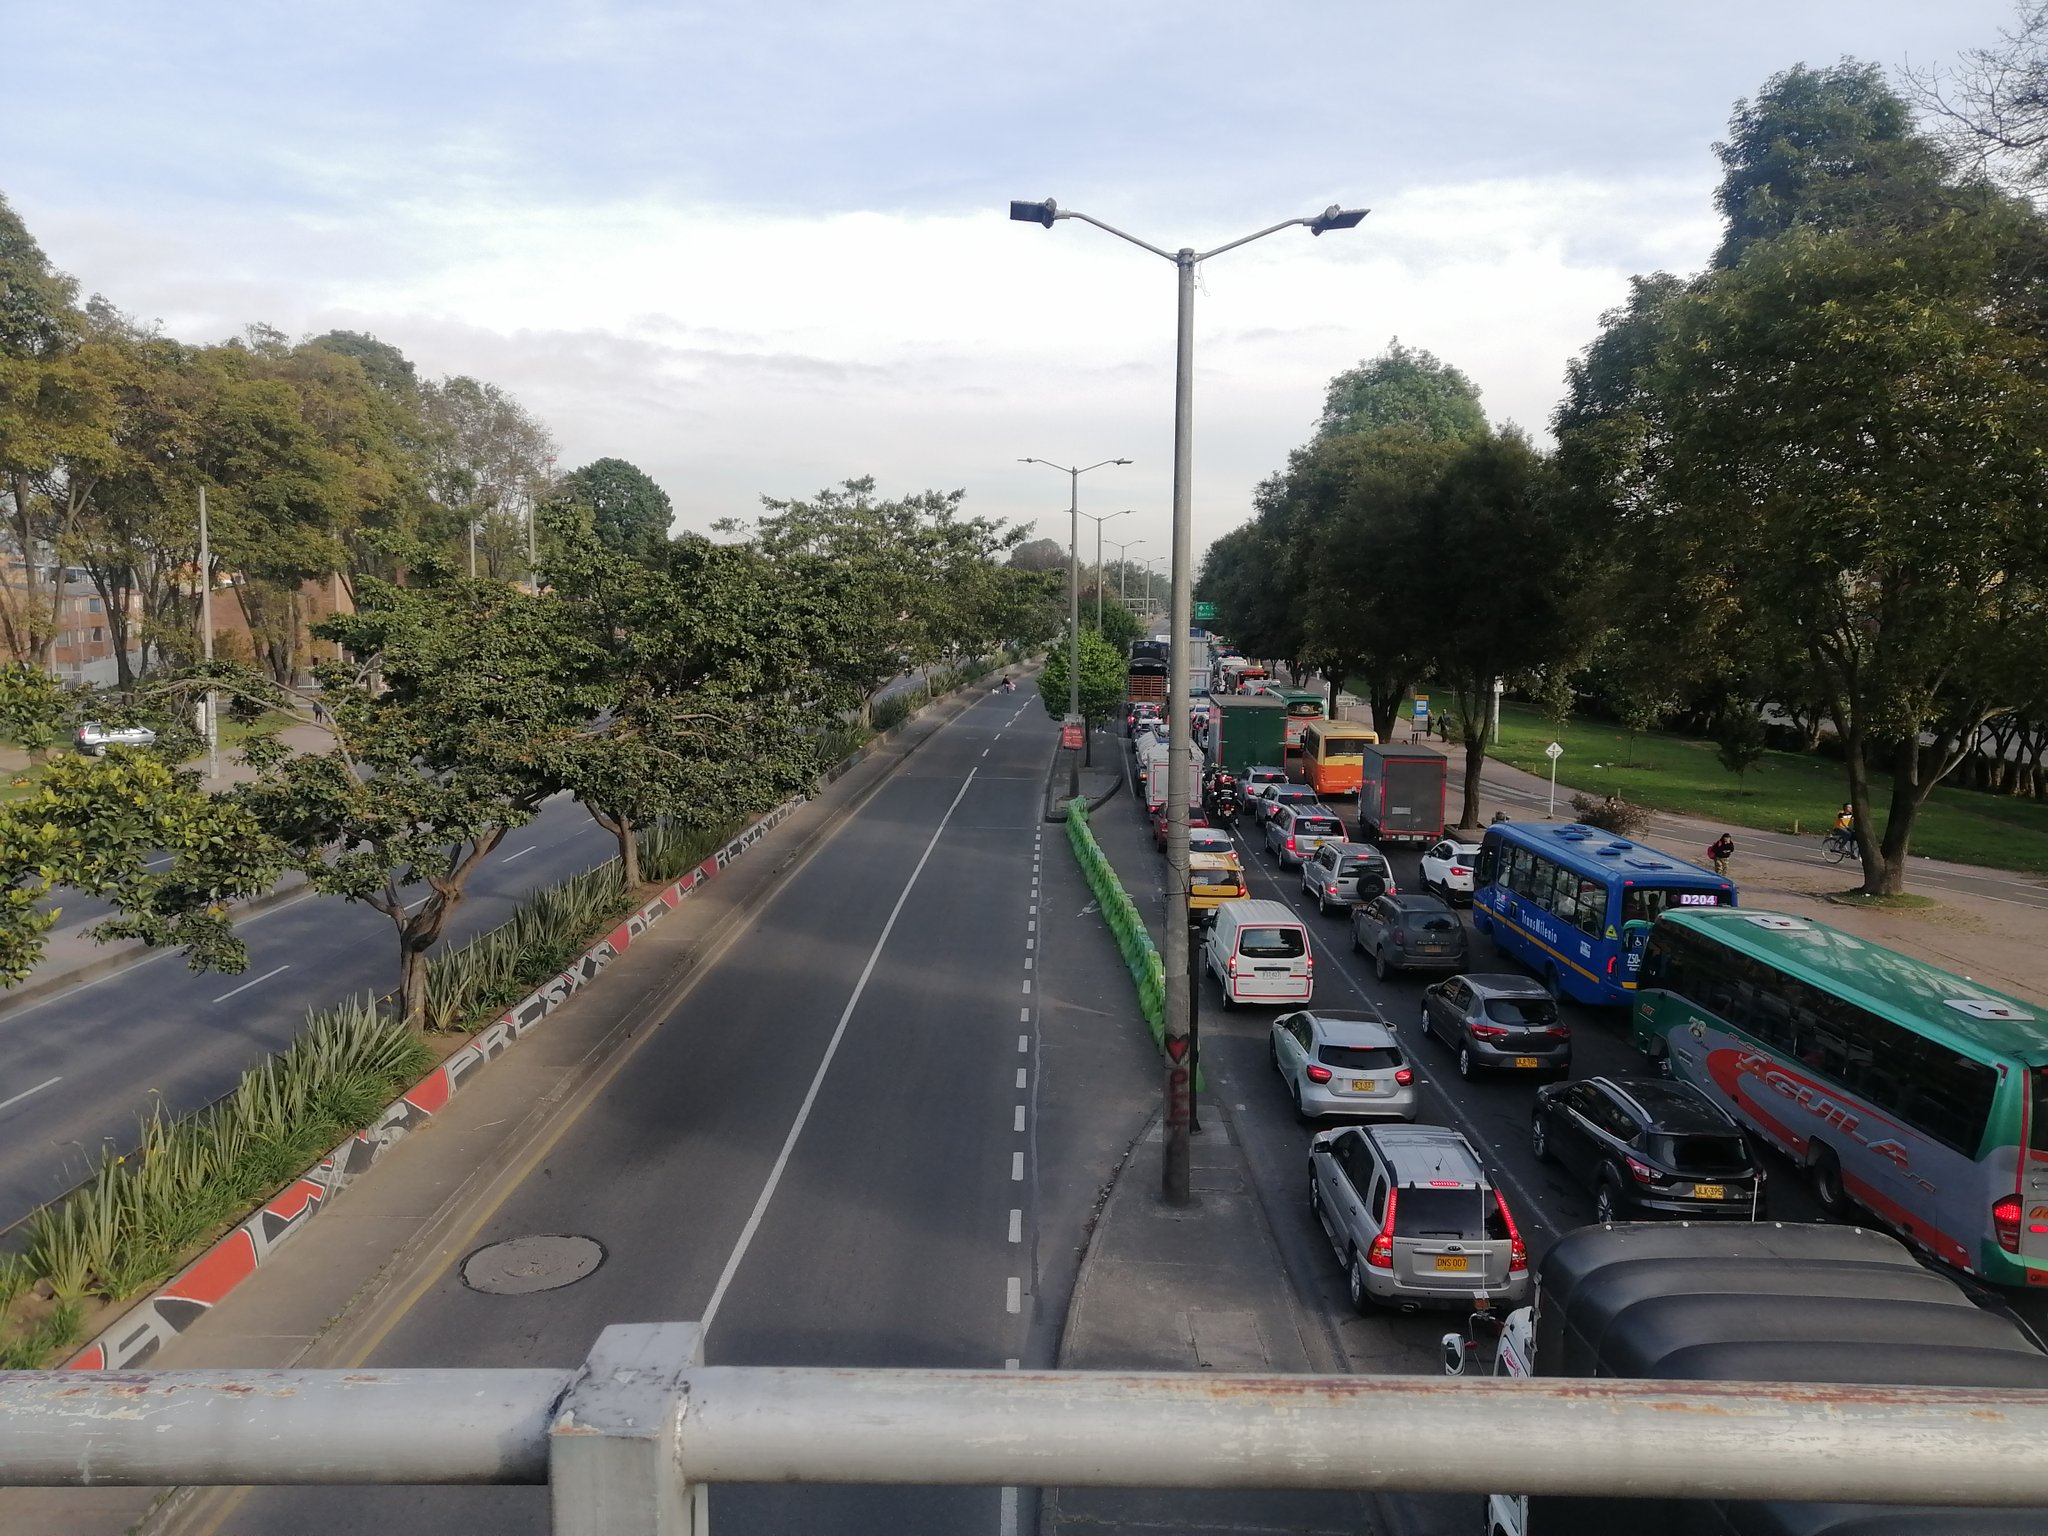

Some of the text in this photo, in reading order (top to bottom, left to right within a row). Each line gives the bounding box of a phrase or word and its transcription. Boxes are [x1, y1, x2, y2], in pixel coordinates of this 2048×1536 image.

[1682, 894, 1716, 906] D204
[1521, 909, 1558, 944] TransMilenio
[443, 939, 614, 1096] PRESXS
[626, 900, 664, 938] DE
[674, 865, 711, 900] LA
[1437, 1258, 1466, 1268] DNS 007
